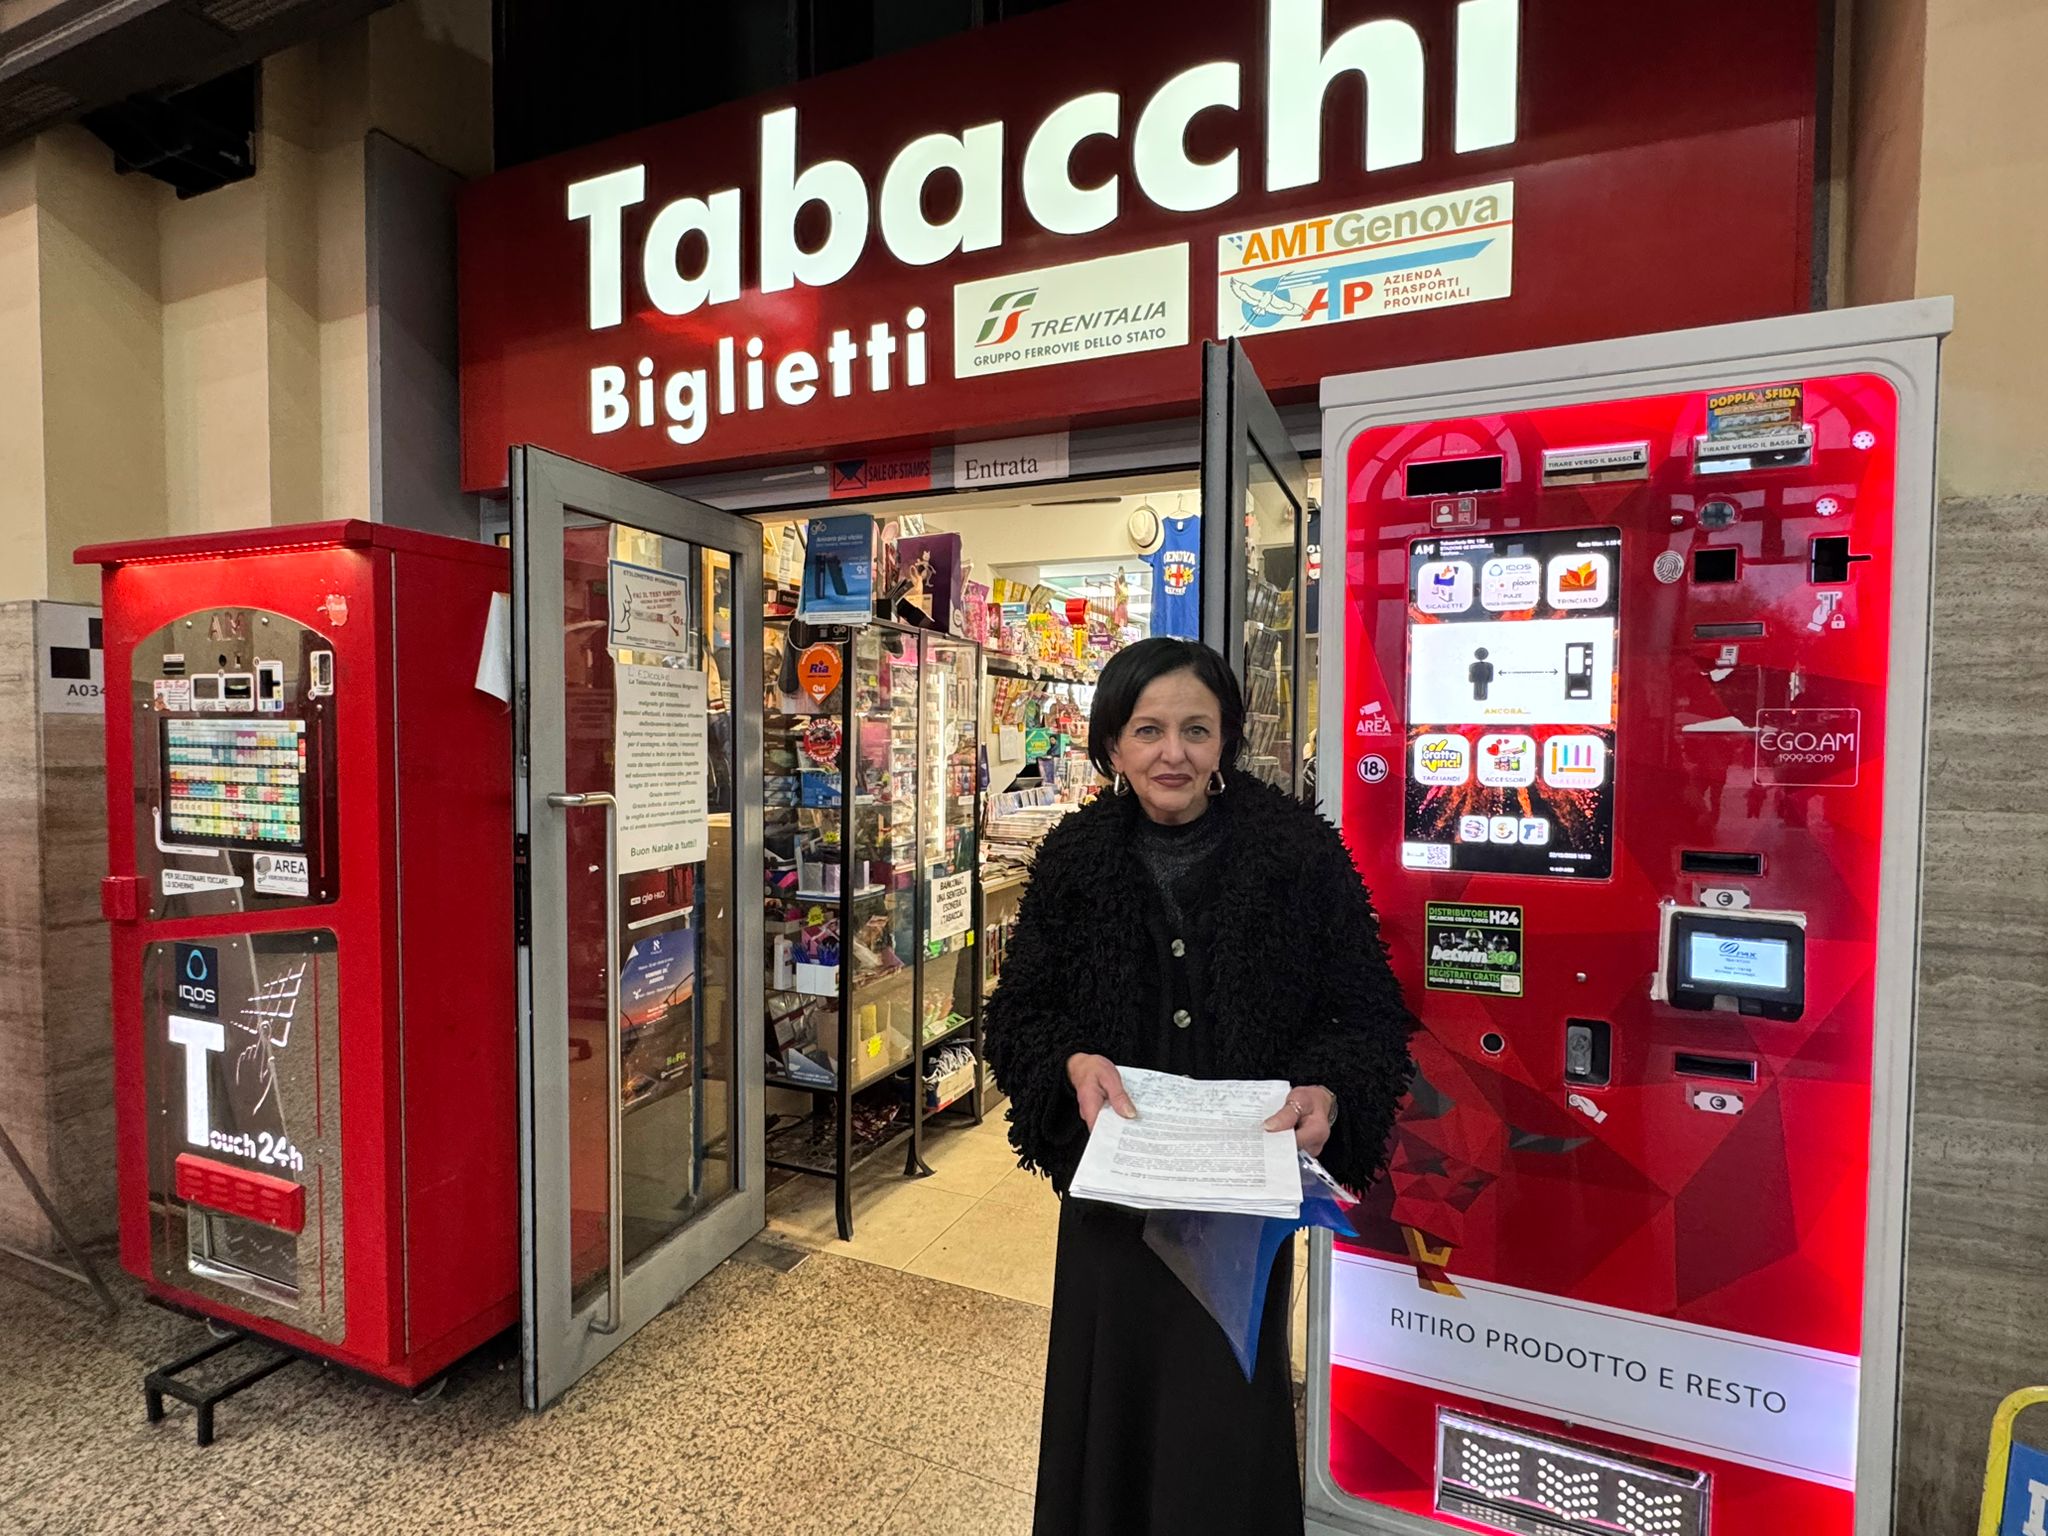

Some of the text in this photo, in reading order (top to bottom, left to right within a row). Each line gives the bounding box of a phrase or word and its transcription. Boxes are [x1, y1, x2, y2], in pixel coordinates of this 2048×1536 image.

[567, 0, 1519, 331] Tabacchi
[1383, 267, 1442, 286] AZIENDA
[1383, 277, 1460, 297] TRASPORTI
[1383, 287, 1471, 309] PROVINCIALI
[1030, 301, 1167, 339] TRENITALIA
[974, 327, 1166, 367] GRUPPO FERROVIE DELLO STATO
[590, 306, 927, 445] Biglietti
[1709, 391, 1755, 409] DOPPIA
[1765, 387, 1801, 400] SFIDA
[1703, 438, 1797, 453] TIRARE VERSO IL BASSO
[868, 460, 930, 482] SALE OF STAMPS
[965, 457, 1039, 481] Entrata
[1548, 455, 1633, 469] TIRARE VERSO IL BASSO
[810, 660, 829, 674] Ria
[1356, 720, 1392, 732] AREA
[1760, 732, 1855, 751] EGO.AM
[1423, 749, 1457, 760] Gratta
[1779, 753, 1835, 763] 1999-2019
[1362, 761, 1384, 776] 18+
[630, 847, 650, 857] Buon
[651, 843, 673, 854] Natale
[275, 859, 306, 875] AREA
[1428, 907, 1519, 926] DISTRIBUTORE H24
[1429, 968, 1500, 981] REGISTRATI GRATIS
[178, 984, 216, 1003] IQOS
[1390, 1308, 1788, 1415] RITIRO PRODOTTO E RESTO
